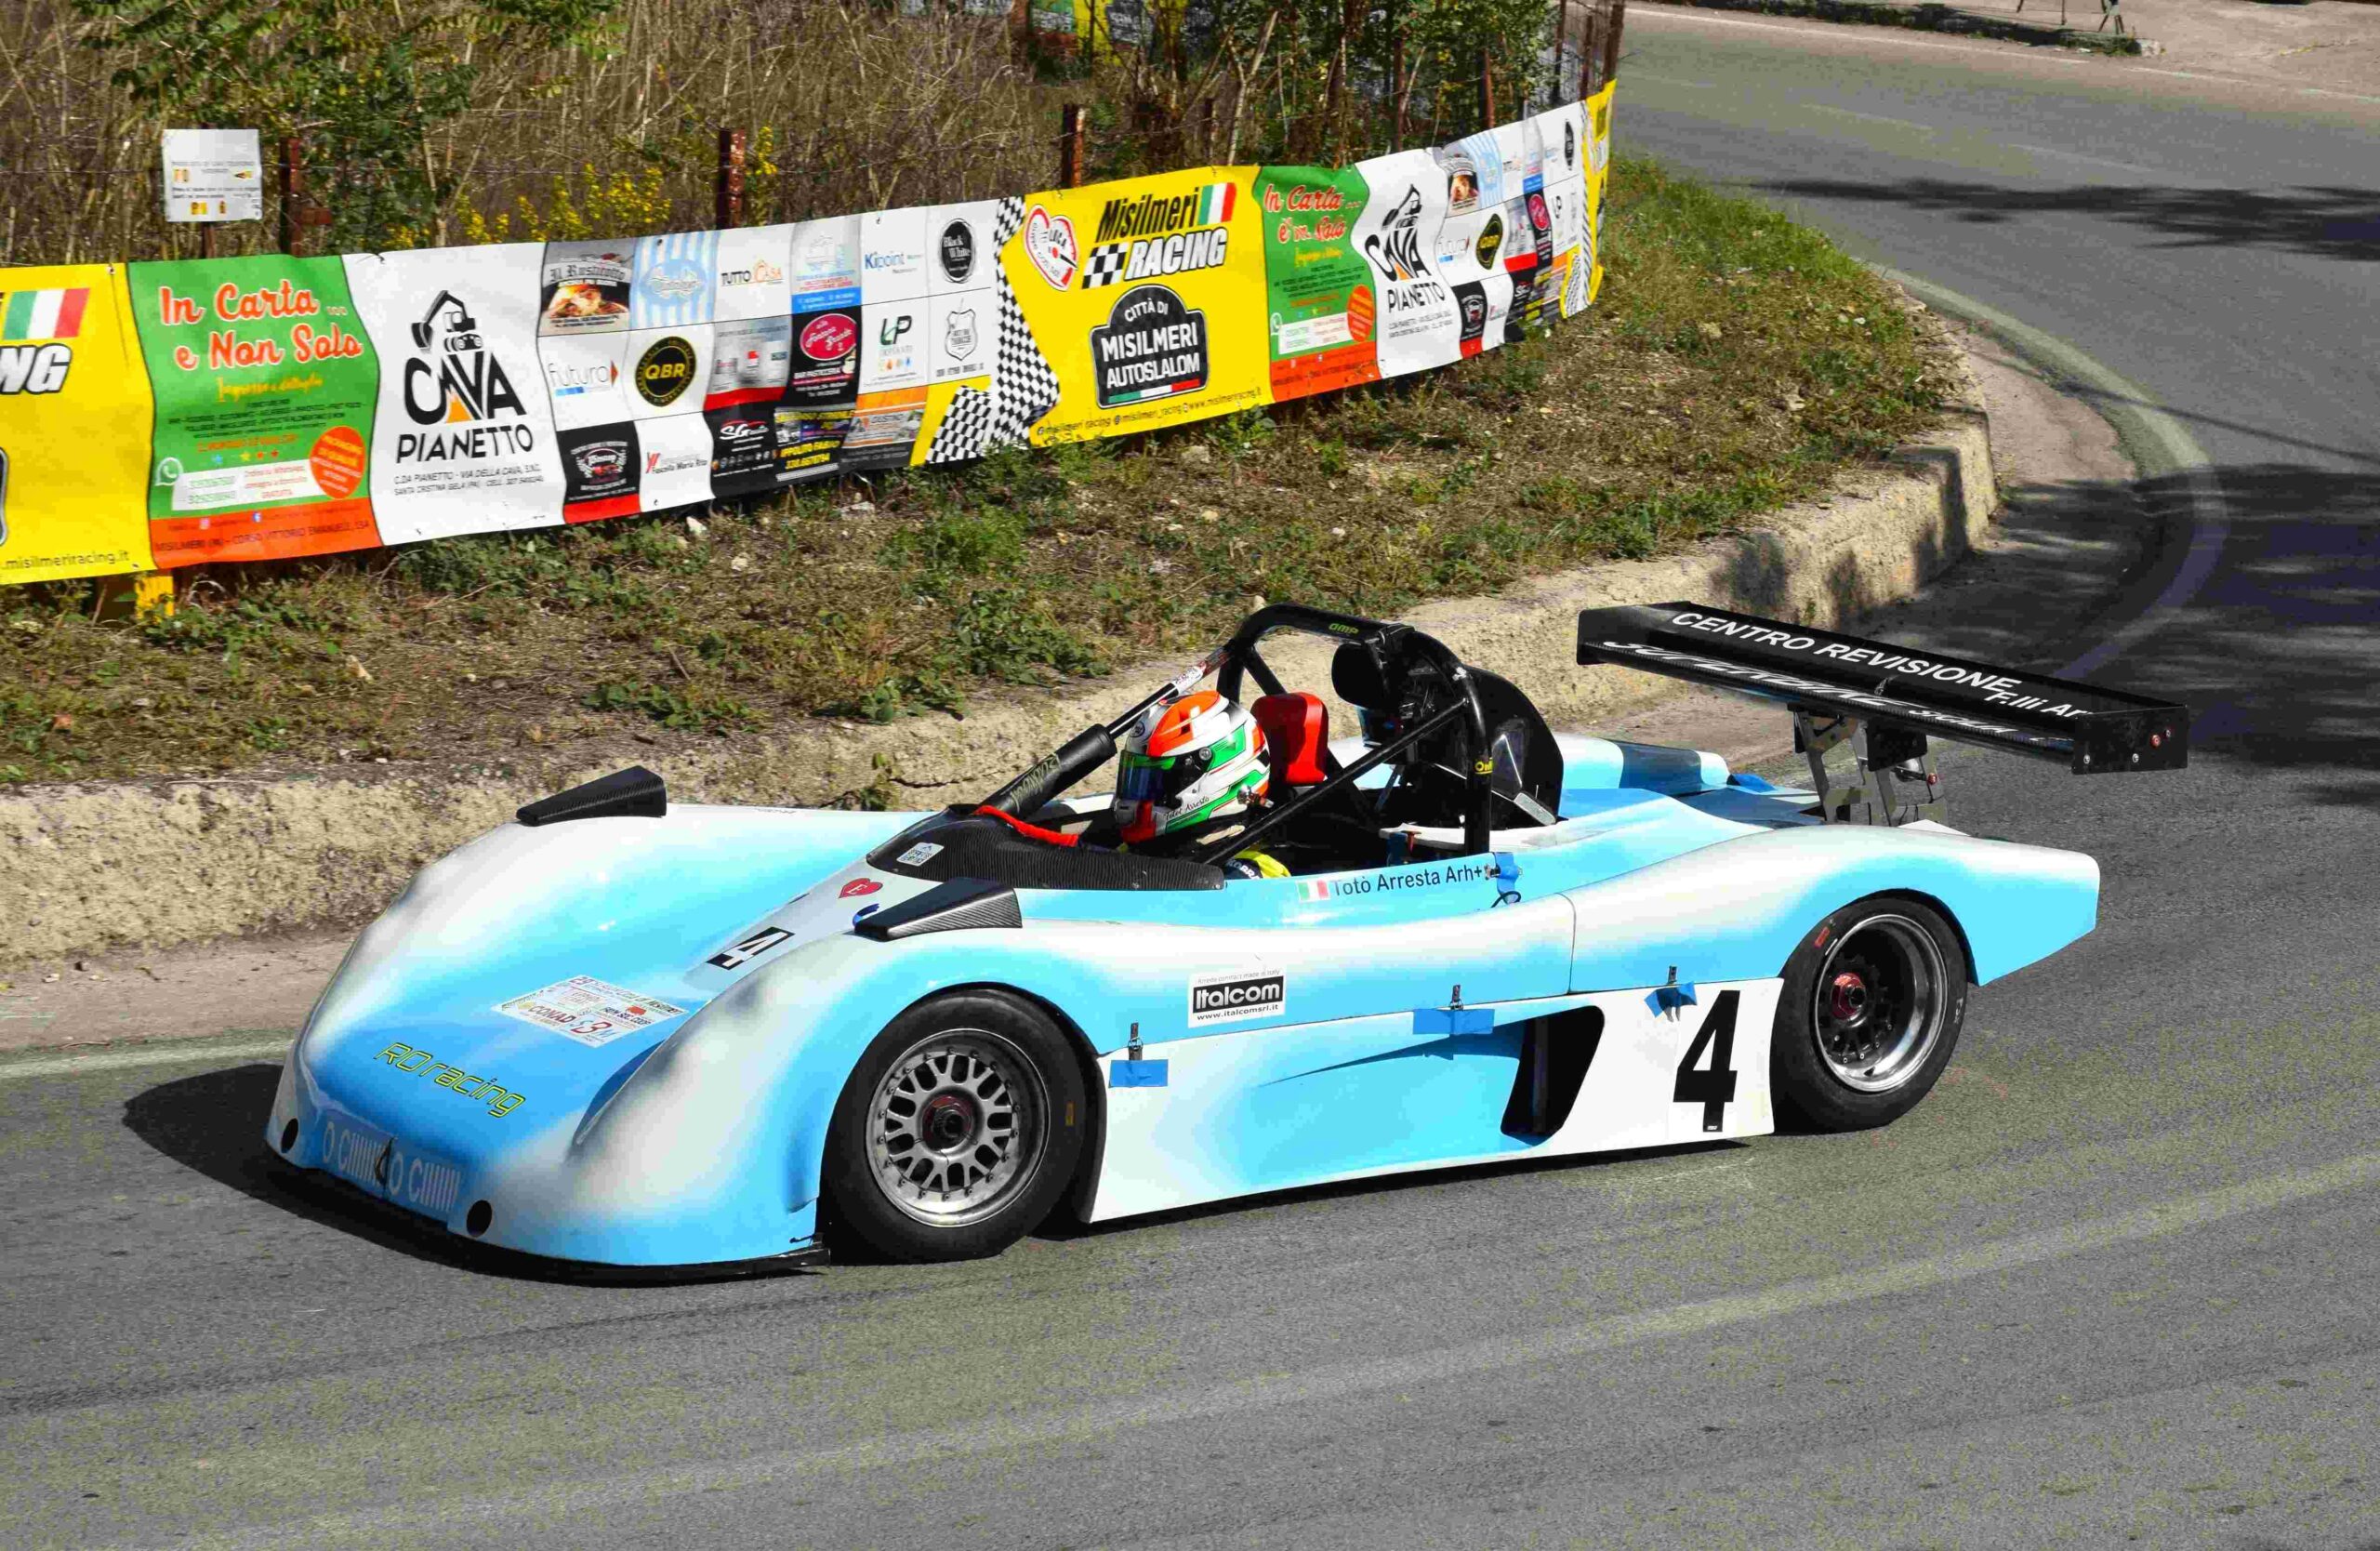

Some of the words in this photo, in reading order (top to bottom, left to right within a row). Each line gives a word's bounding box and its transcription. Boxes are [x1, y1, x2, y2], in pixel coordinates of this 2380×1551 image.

[1095, 187, 1199, 244] Misilmeri
[1124, 226, 1228, 282] RACING
[159, 286, 206, 325] In
[214, 279, 320, 322] Carta
[1125, 298, 1156, 322] CITTÀ
[1157, 299, 1169, 315] DI
[1388, 282, 1445, 312] PIANETTO
[174, 345, 199, 370] e
[209, 329, 286, 370] Non
[290, 323, 364, 364] Solo
[1101, 322, 1198, 362] MISILMERI
[404, 350, 527, 425] CAVA
[645, 364, 686, 380] QBR
[1106, 352, 1201, 391] AUTOSLALOM
[396, 423, 534, 464] PIANETTO
[1673, 613, 1816, 650] CENTRO
[1814, 643, 2022, 693] REVISIONE
[1984, 691, 2050, 710] F.lli
[1332, 876, 1371, 896] Totò
[1376, 868, 1441, 891] Arresta
[529, 1005, 576, 1024] CONAD
[1196, 984, 1280, 1010] Italcom
[1197, 1003, 1279, 1021] www.italcomsrl.it
[1673, 989, 1741, 1133] 4
[418, 1063, 526, 1119] racing
